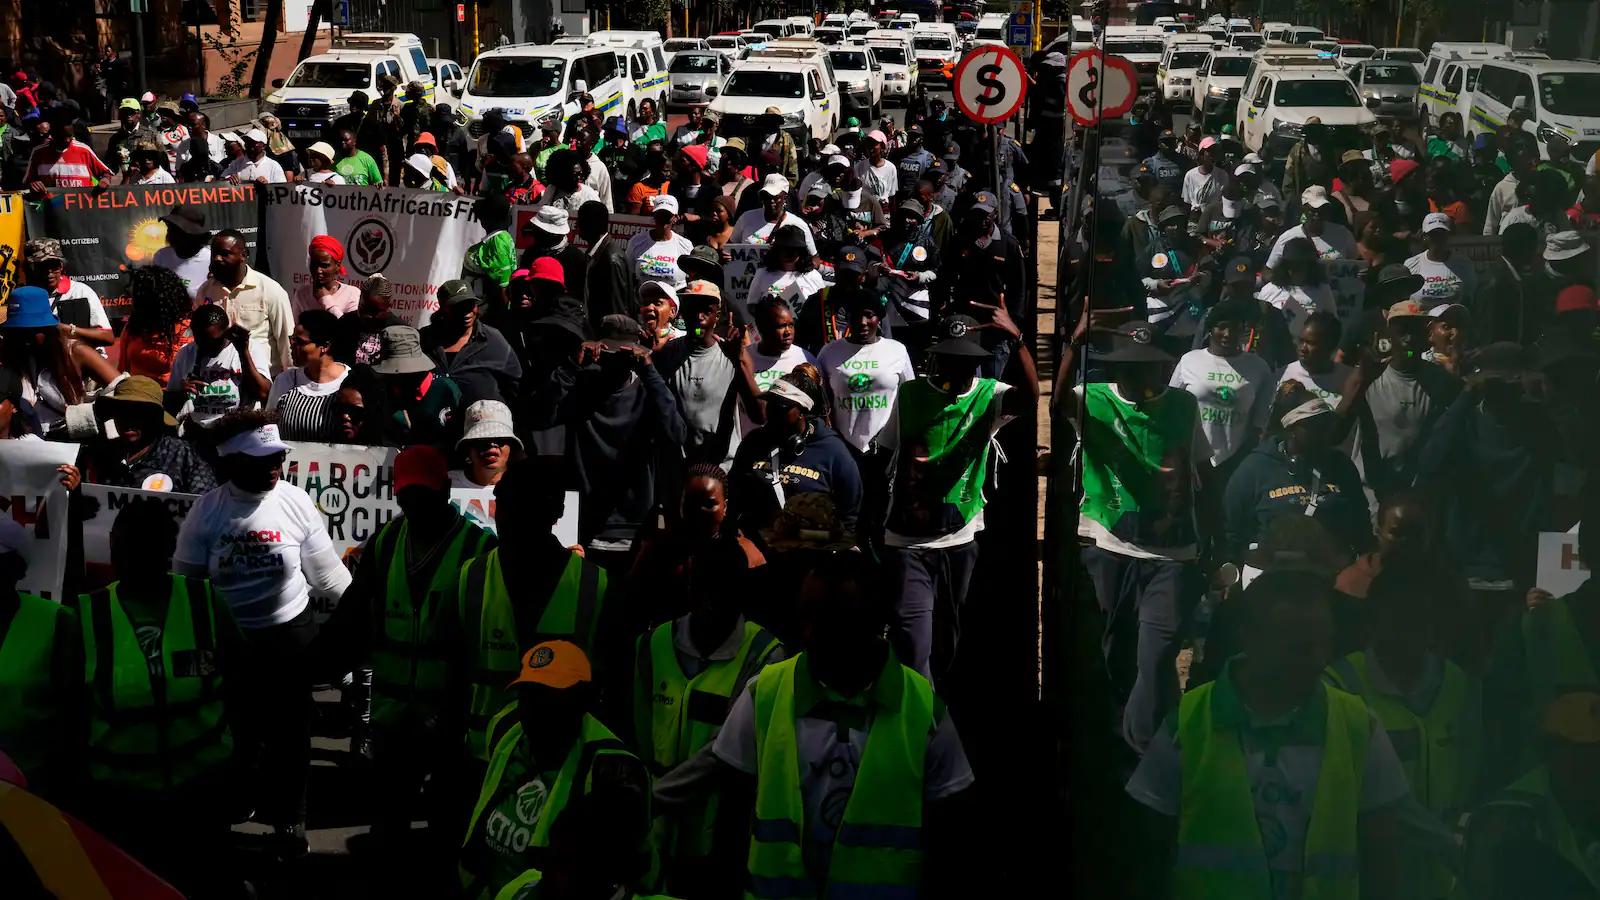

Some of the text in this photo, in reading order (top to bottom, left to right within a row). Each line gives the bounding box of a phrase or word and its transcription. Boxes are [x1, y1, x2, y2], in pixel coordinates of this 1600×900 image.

[975, 64, 1006, 106] S
[900, 162, 920, 172] POLICE
[64, 185, 257, 210] FIYELA MOVEMENT
[86, 273, 119, 282] HIJACKING
[843, 360, 879, 370] VOTE
[838, 395, 887, 410] ACTIONSA
[325, 493, 340, 509] IN
[327, 507, 393, 542] RCH
[218, 553, 284, 569] MARCH
